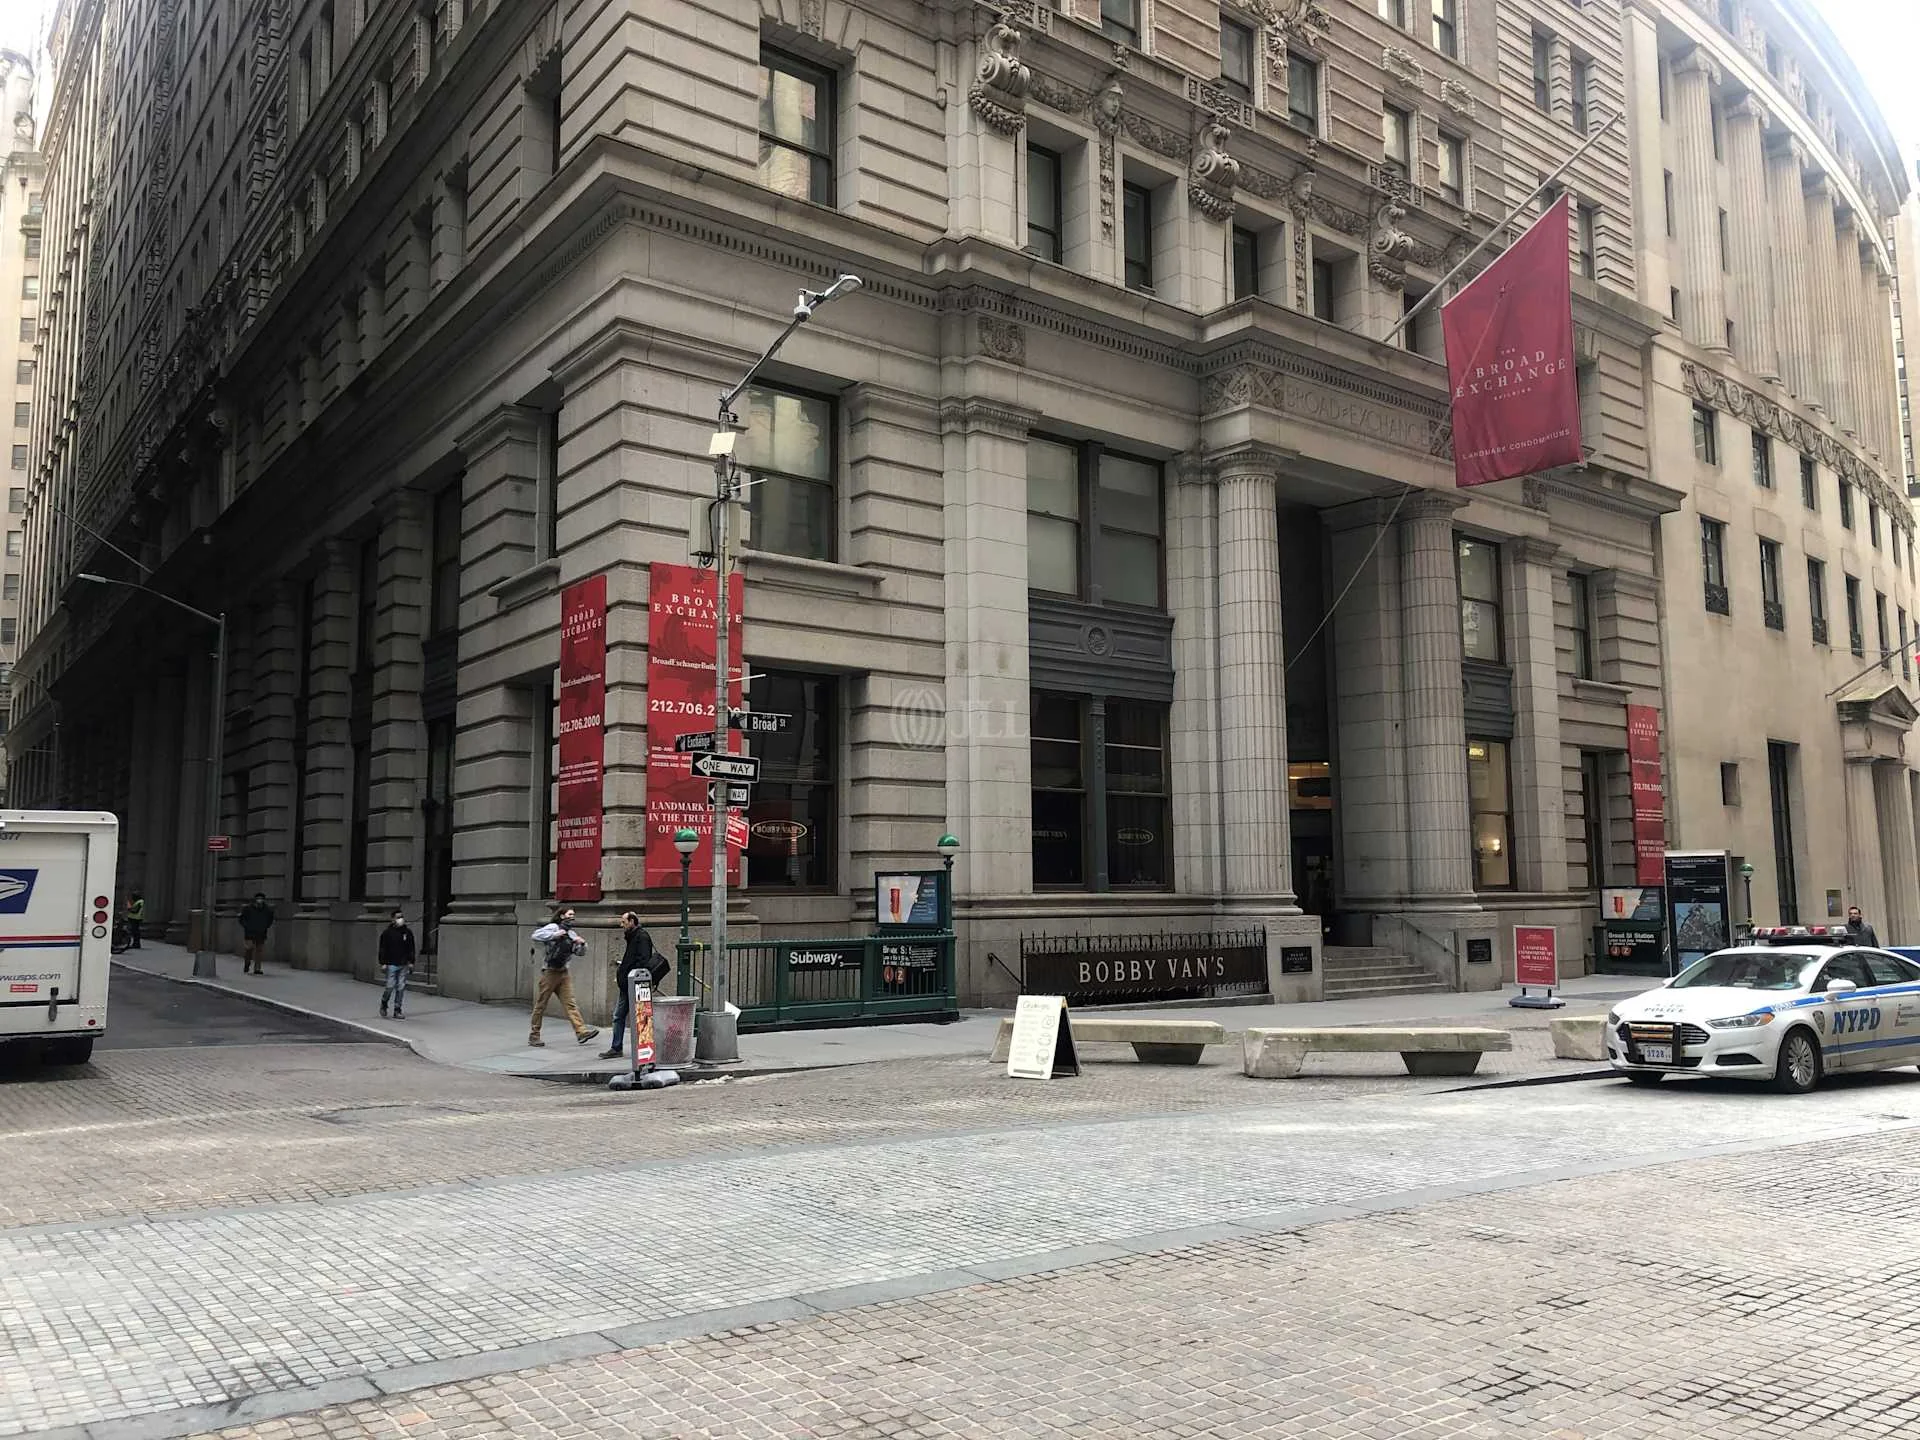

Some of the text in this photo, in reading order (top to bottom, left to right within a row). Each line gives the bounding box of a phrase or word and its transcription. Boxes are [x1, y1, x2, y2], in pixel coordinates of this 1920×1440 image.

[1475, 350, 1546, 379] BROAD
[1455, 358, 1568, 398] EXCHANGE
[1462, 446, 1507, 460] LANDMARK
[671, 593, 714, 609] BROA
[569, 608, 594, 626] BROAD
[562, 617, 602, 639] EXCHANGE
[560, 714, 600, 733] 212.706.2000
[752, 716, 777, 731] Broad
[687, 735, 710, 750] Exchange
[702, 760, 721, 771] ONE
[730, 763, 750, 775] WAY
[732, 789, 745, 800] WAY
[651, 801, 705, 812] LANDMARK
[649, 813, 660, 822] IN
[661, 814, 681, 822] THE
[683, 814, 707, 823] TRUE
[658, 824, 672, 833] OF
[789, 951, 838, 966] Subway
[1079, 956, 1225, 983] BOBBY VAN'S
[635, 983, 651, 1002] Pizza
[1832, 1007, 1881, 1035] NYPD
